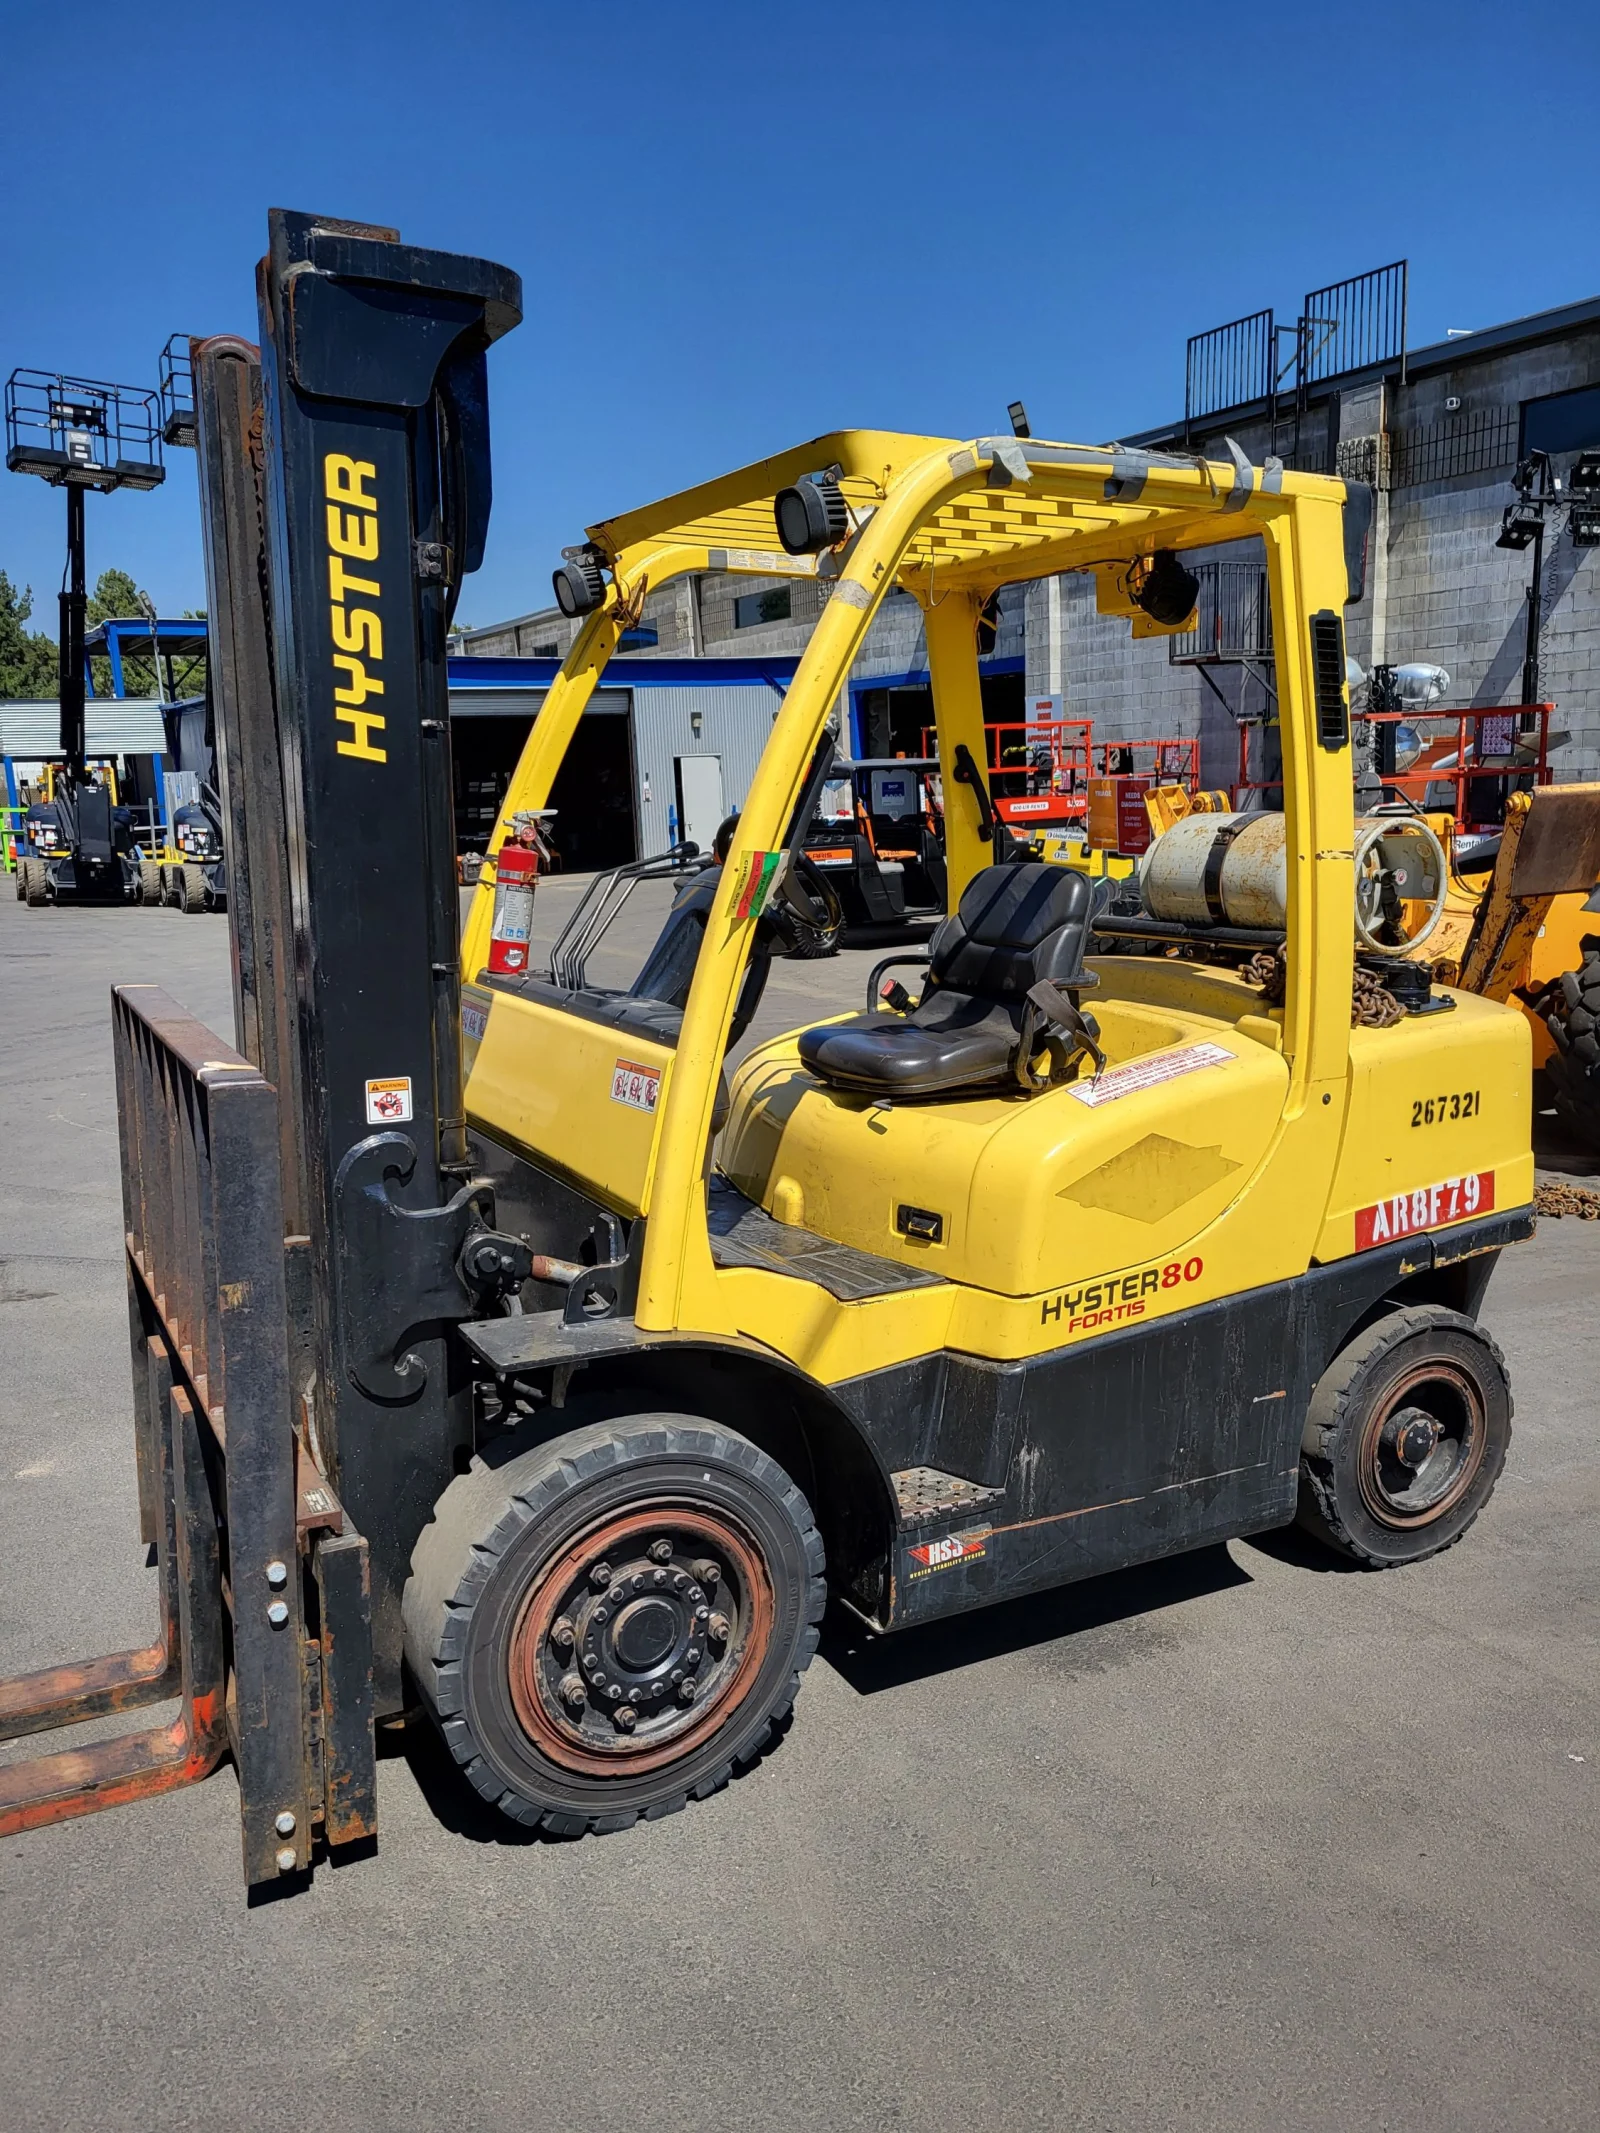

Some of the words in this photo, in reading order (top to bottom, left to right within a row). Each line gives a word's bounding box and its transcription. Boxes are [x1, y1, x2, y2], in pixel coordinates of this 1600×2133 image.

[325, 453, 387, 763] HYSTER
[739, 860, 749, 889] CHECK
[732, 892, 740, 909] OUT
[1411, 1090, 1480, 1127] 267321
[1068, 1300, 1146, 1333] FORTIS
[933, 1557, 962, 1572] STABILITY
[964, 1549, 986, 1562] SYSTEM
